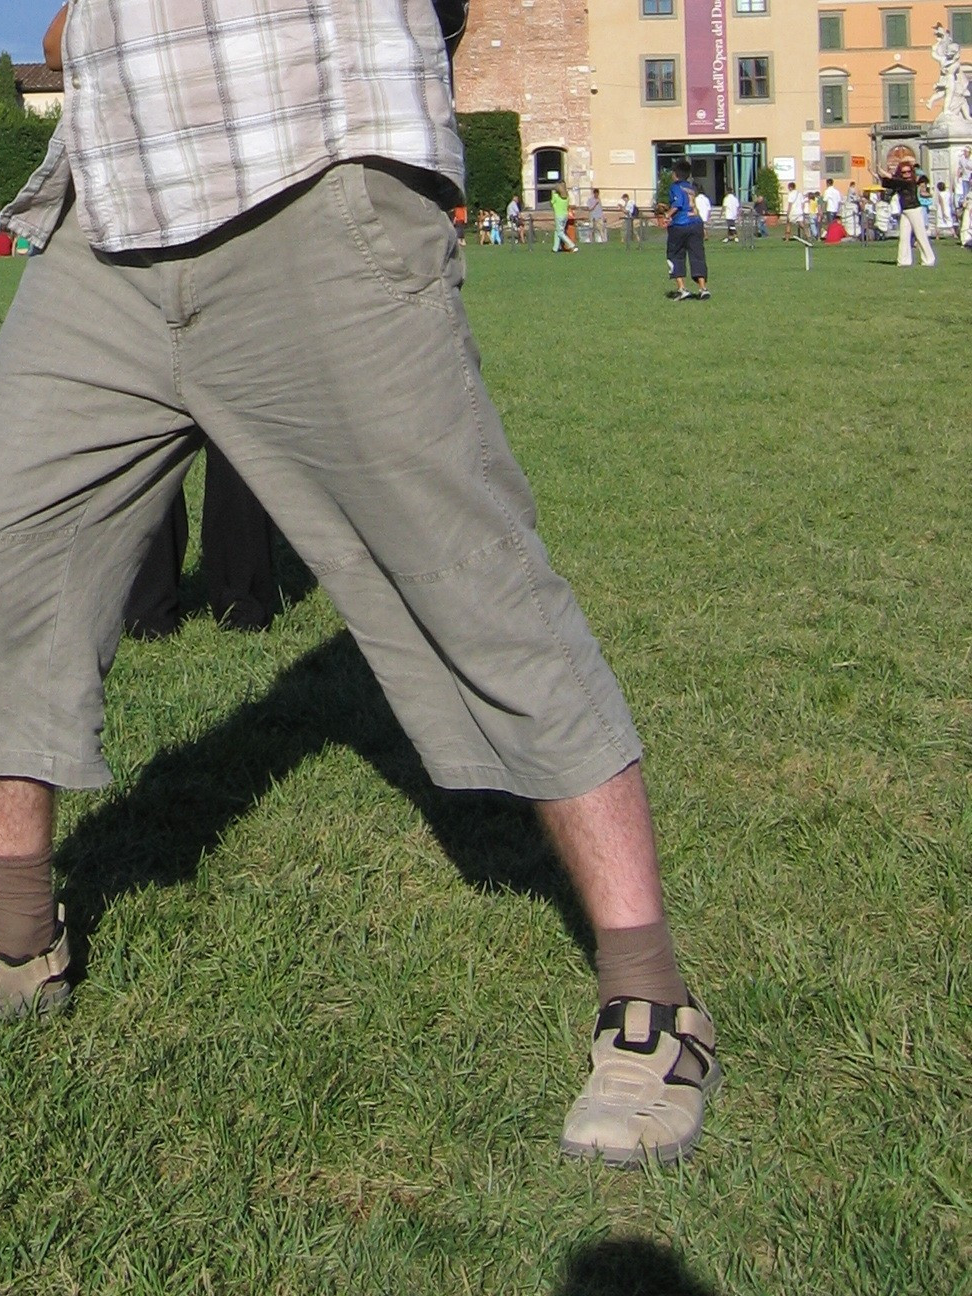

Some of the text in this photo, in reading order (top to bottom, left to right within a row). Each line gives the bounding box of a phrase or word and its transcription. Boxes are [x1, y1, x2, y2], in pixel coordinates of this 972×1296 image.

[711, 20, 722, 36] del
[712, 39, 726, 92] dell'Opera
[714, 94, 726, 131] Museo
